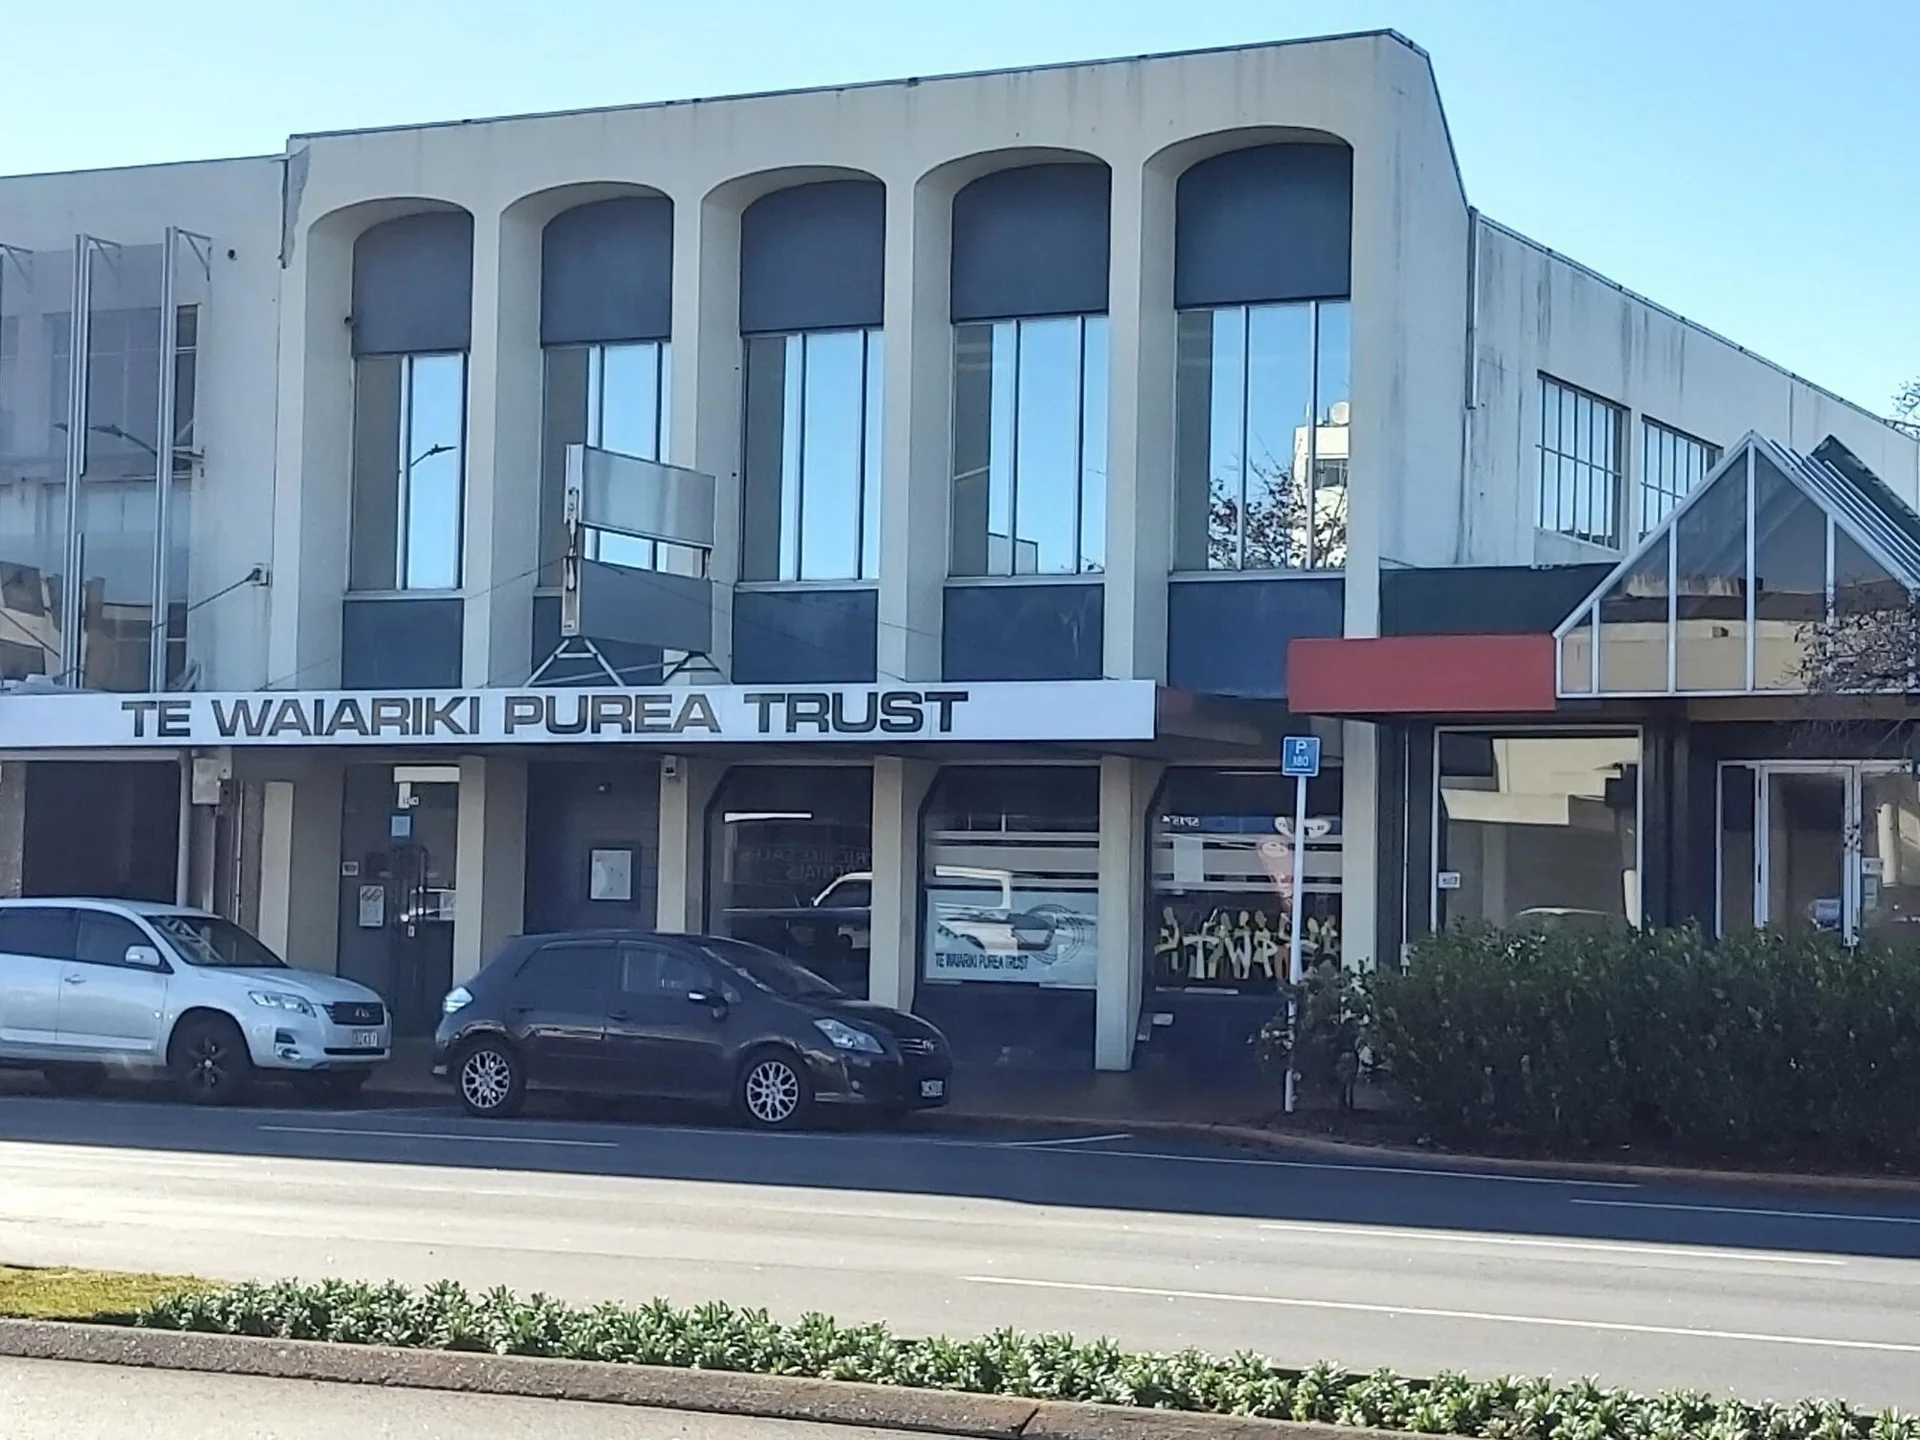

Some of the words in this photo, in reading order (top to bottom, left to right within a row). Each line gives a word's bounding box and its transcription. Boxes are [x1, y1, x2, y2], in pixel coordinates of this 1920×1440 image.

[122, 700, 190, 738] TE
[211, 696, 480, 737] WAIARIKI
[504, 693, 722, 735] PUREA
[744, 691, 969, 734] TRUST
[1295, 740, 1307, 754] P
[935, 952, 944, 968] TE
